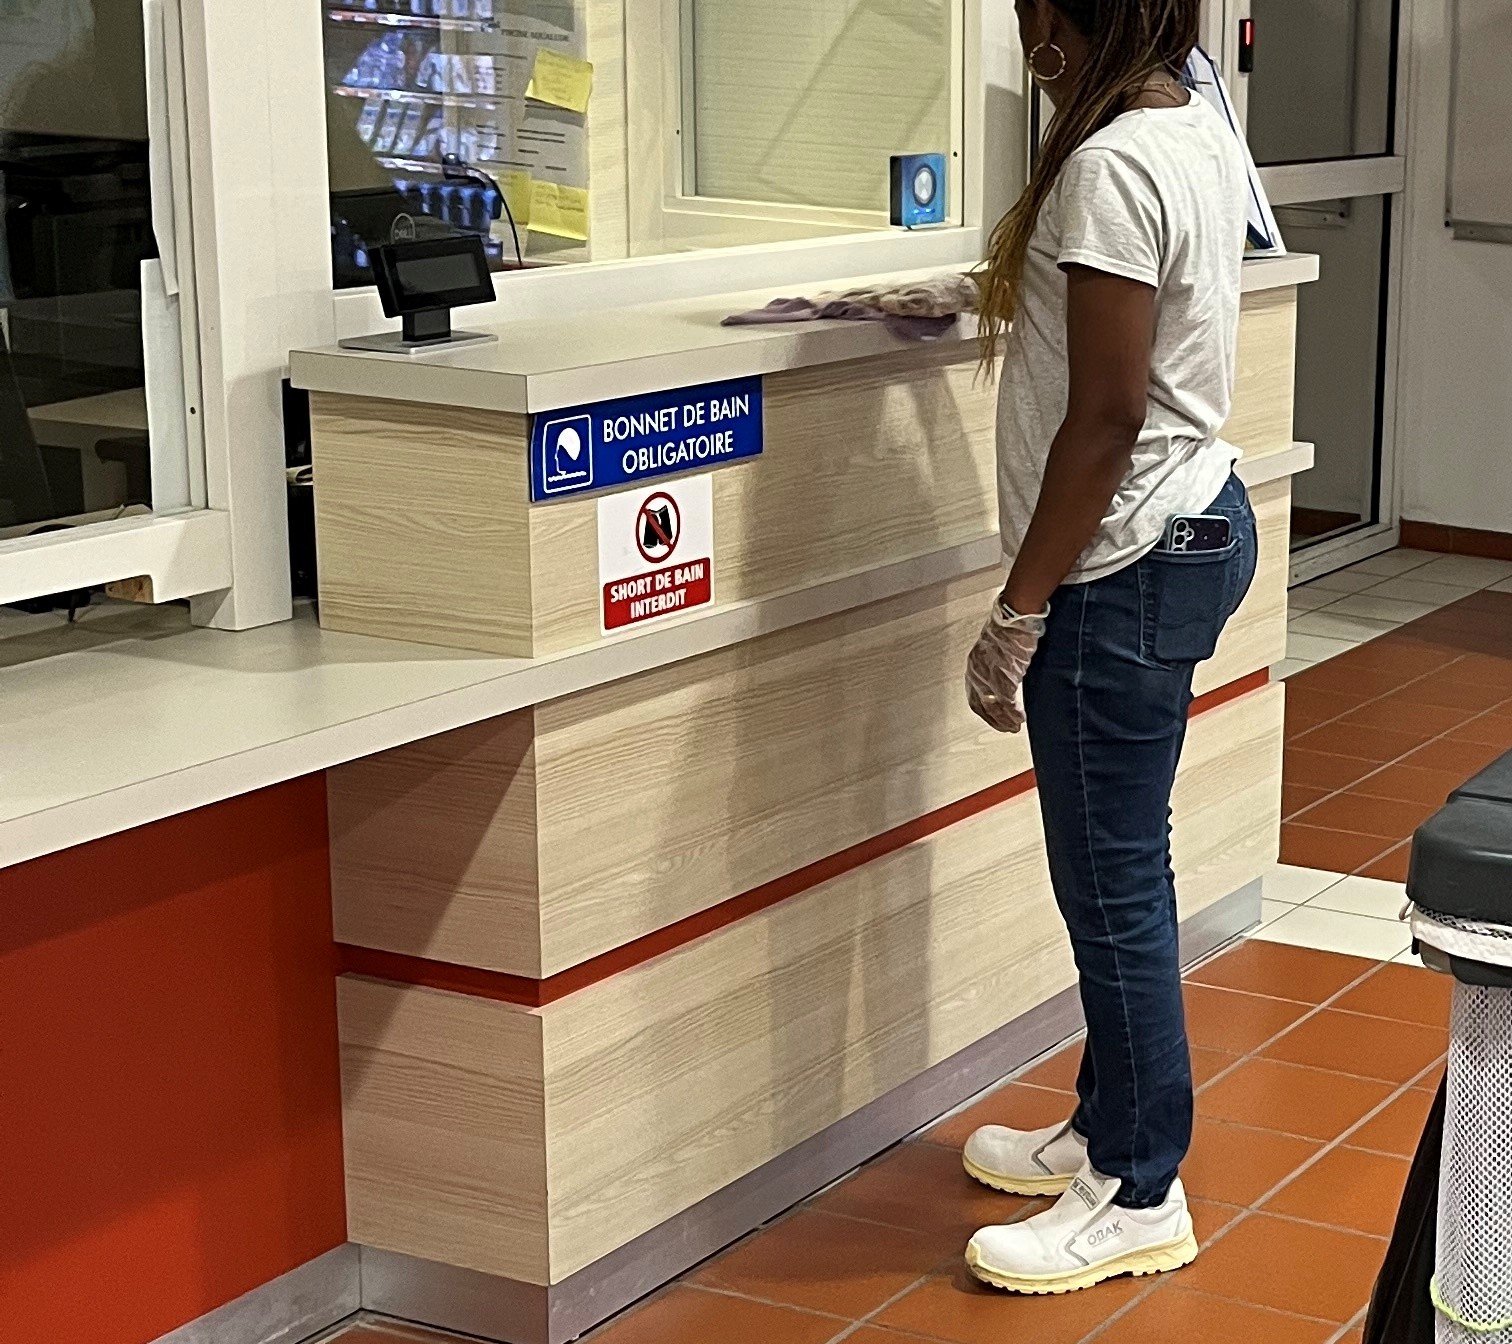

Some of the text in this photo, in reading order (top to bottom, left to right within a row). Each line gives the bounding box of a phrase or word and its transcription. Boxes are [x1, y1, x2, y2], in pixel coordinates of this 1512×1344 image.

[603, 394, 749, 443] BONNET DE BAIN
[622, 430, 734, 474] OBLIGATOIRE
[610, 562, 704, 603] SHORT DE BAIN
[630, 588, 687, 619] INTERDIT
